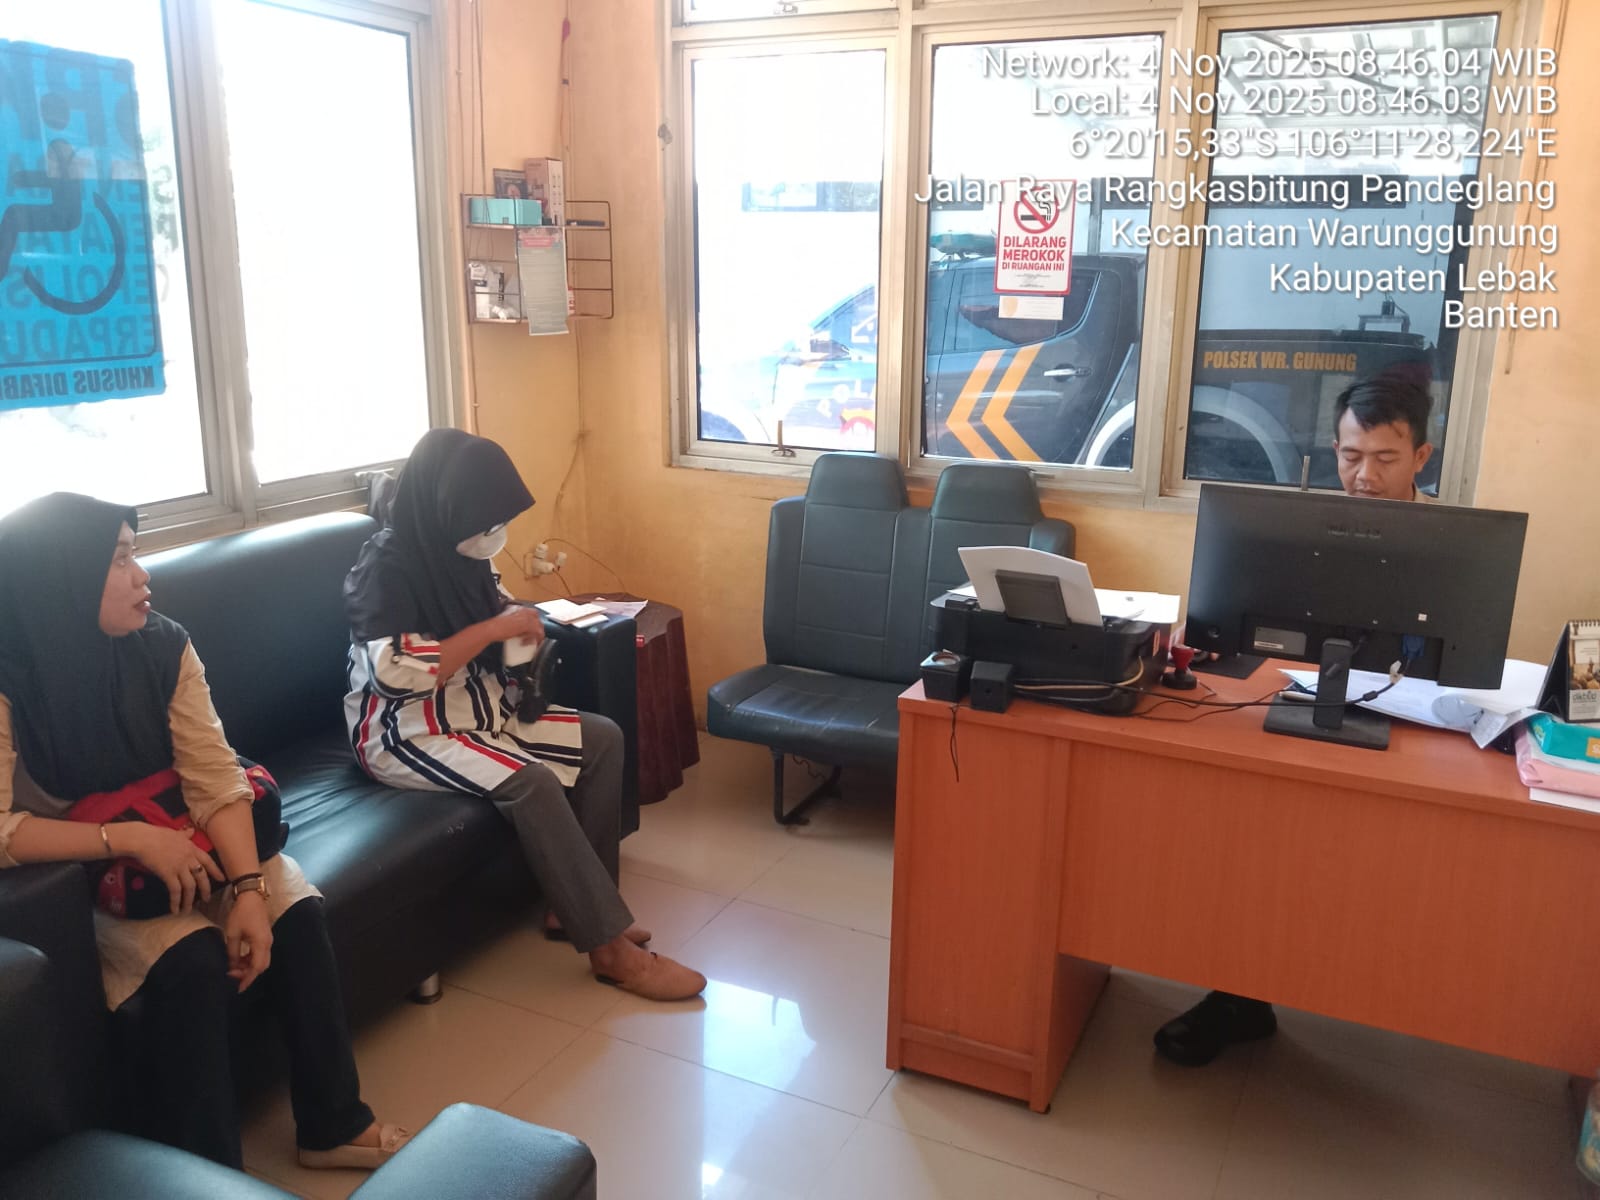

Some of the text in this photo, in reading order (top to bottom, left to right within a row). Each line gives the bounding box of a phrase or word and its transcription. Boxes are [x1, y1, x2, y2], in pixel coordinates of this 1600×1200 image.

[1003, 236, 1067, 248] DILARANG
[1003, 249, 1065, 261] MEROKOK
[1002, 262, 1065, 271] DI RUANGAN INI
[1203, 351, 1357, 372] POLSEK WR. GUNUNG
